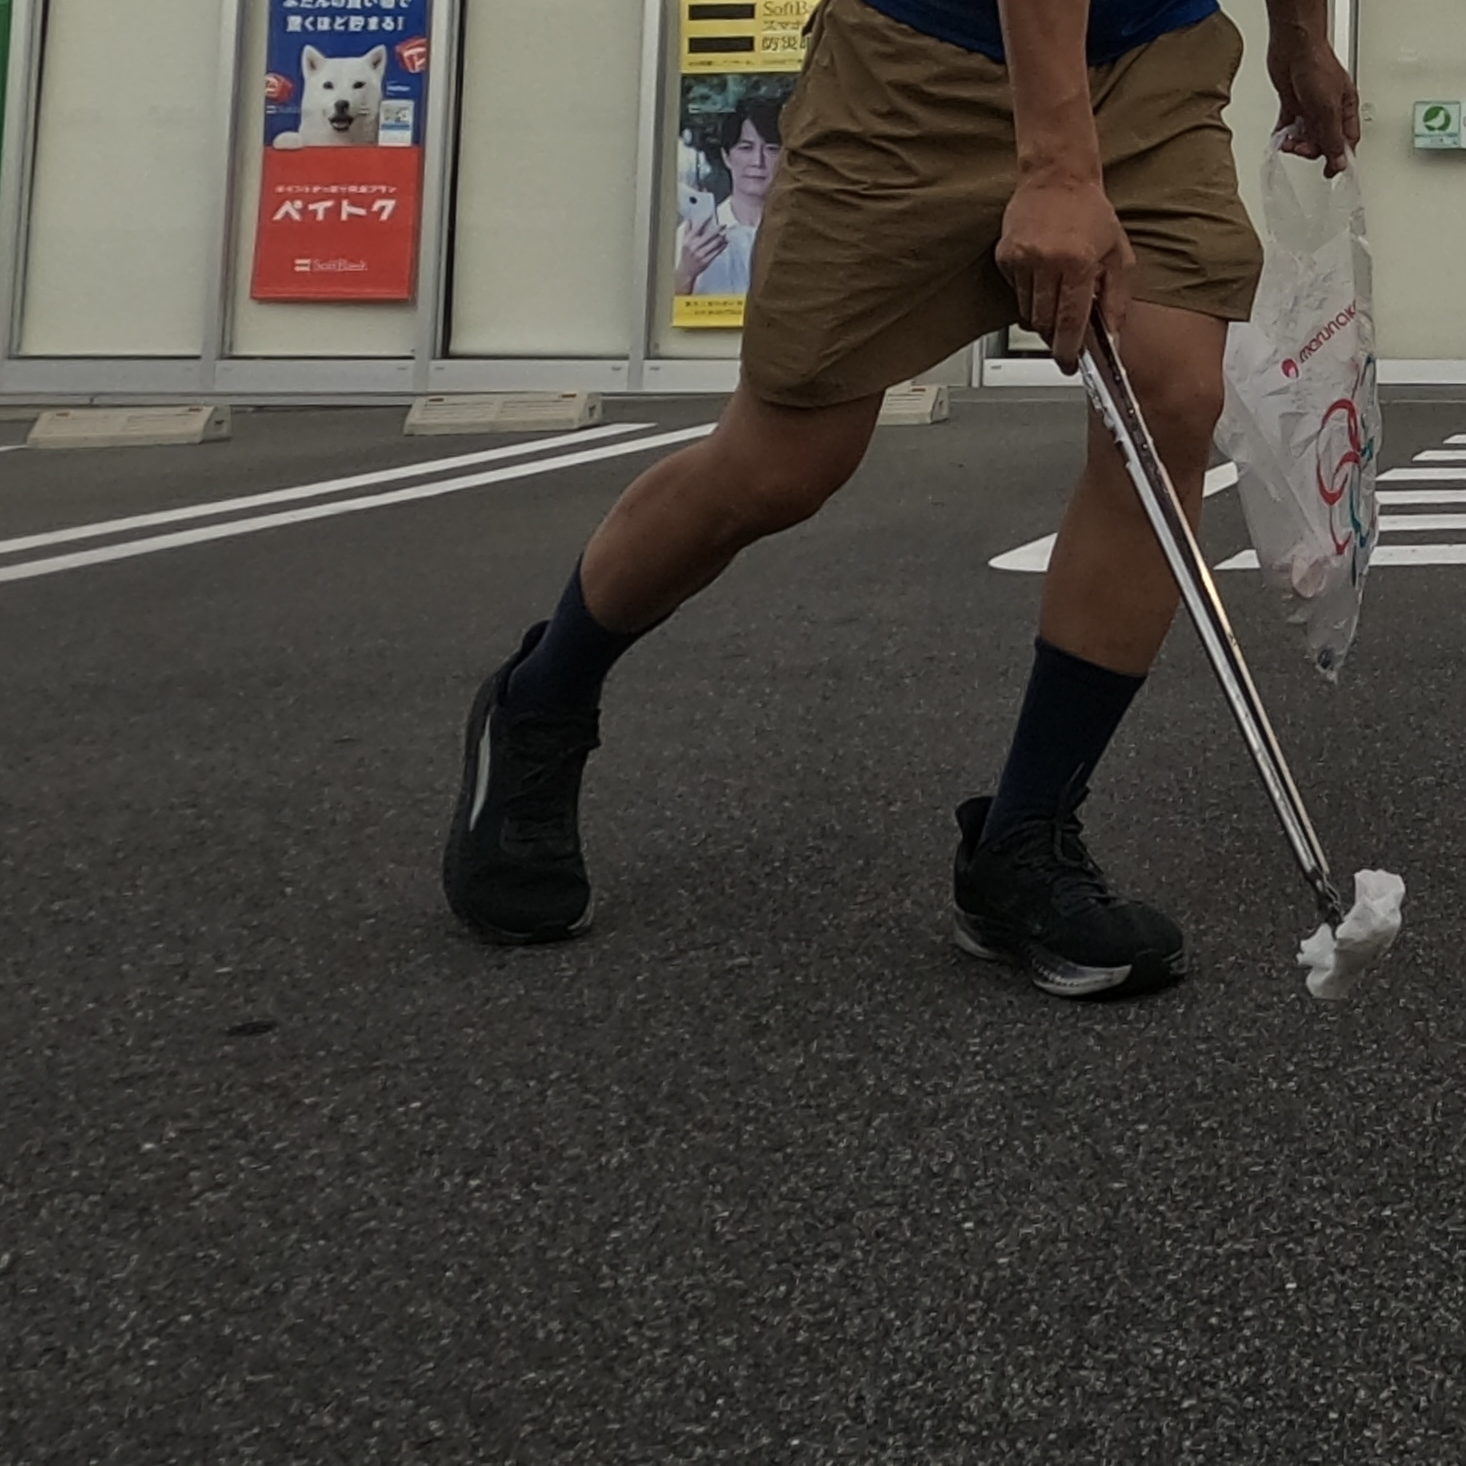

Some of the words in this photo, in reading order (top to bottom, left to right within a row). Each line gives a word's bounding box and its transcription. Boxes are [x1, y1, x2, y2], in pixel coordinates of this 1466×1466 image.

[762, 0, 817, 17] SoftB
[271, 198, 398, 222] ペイトク
